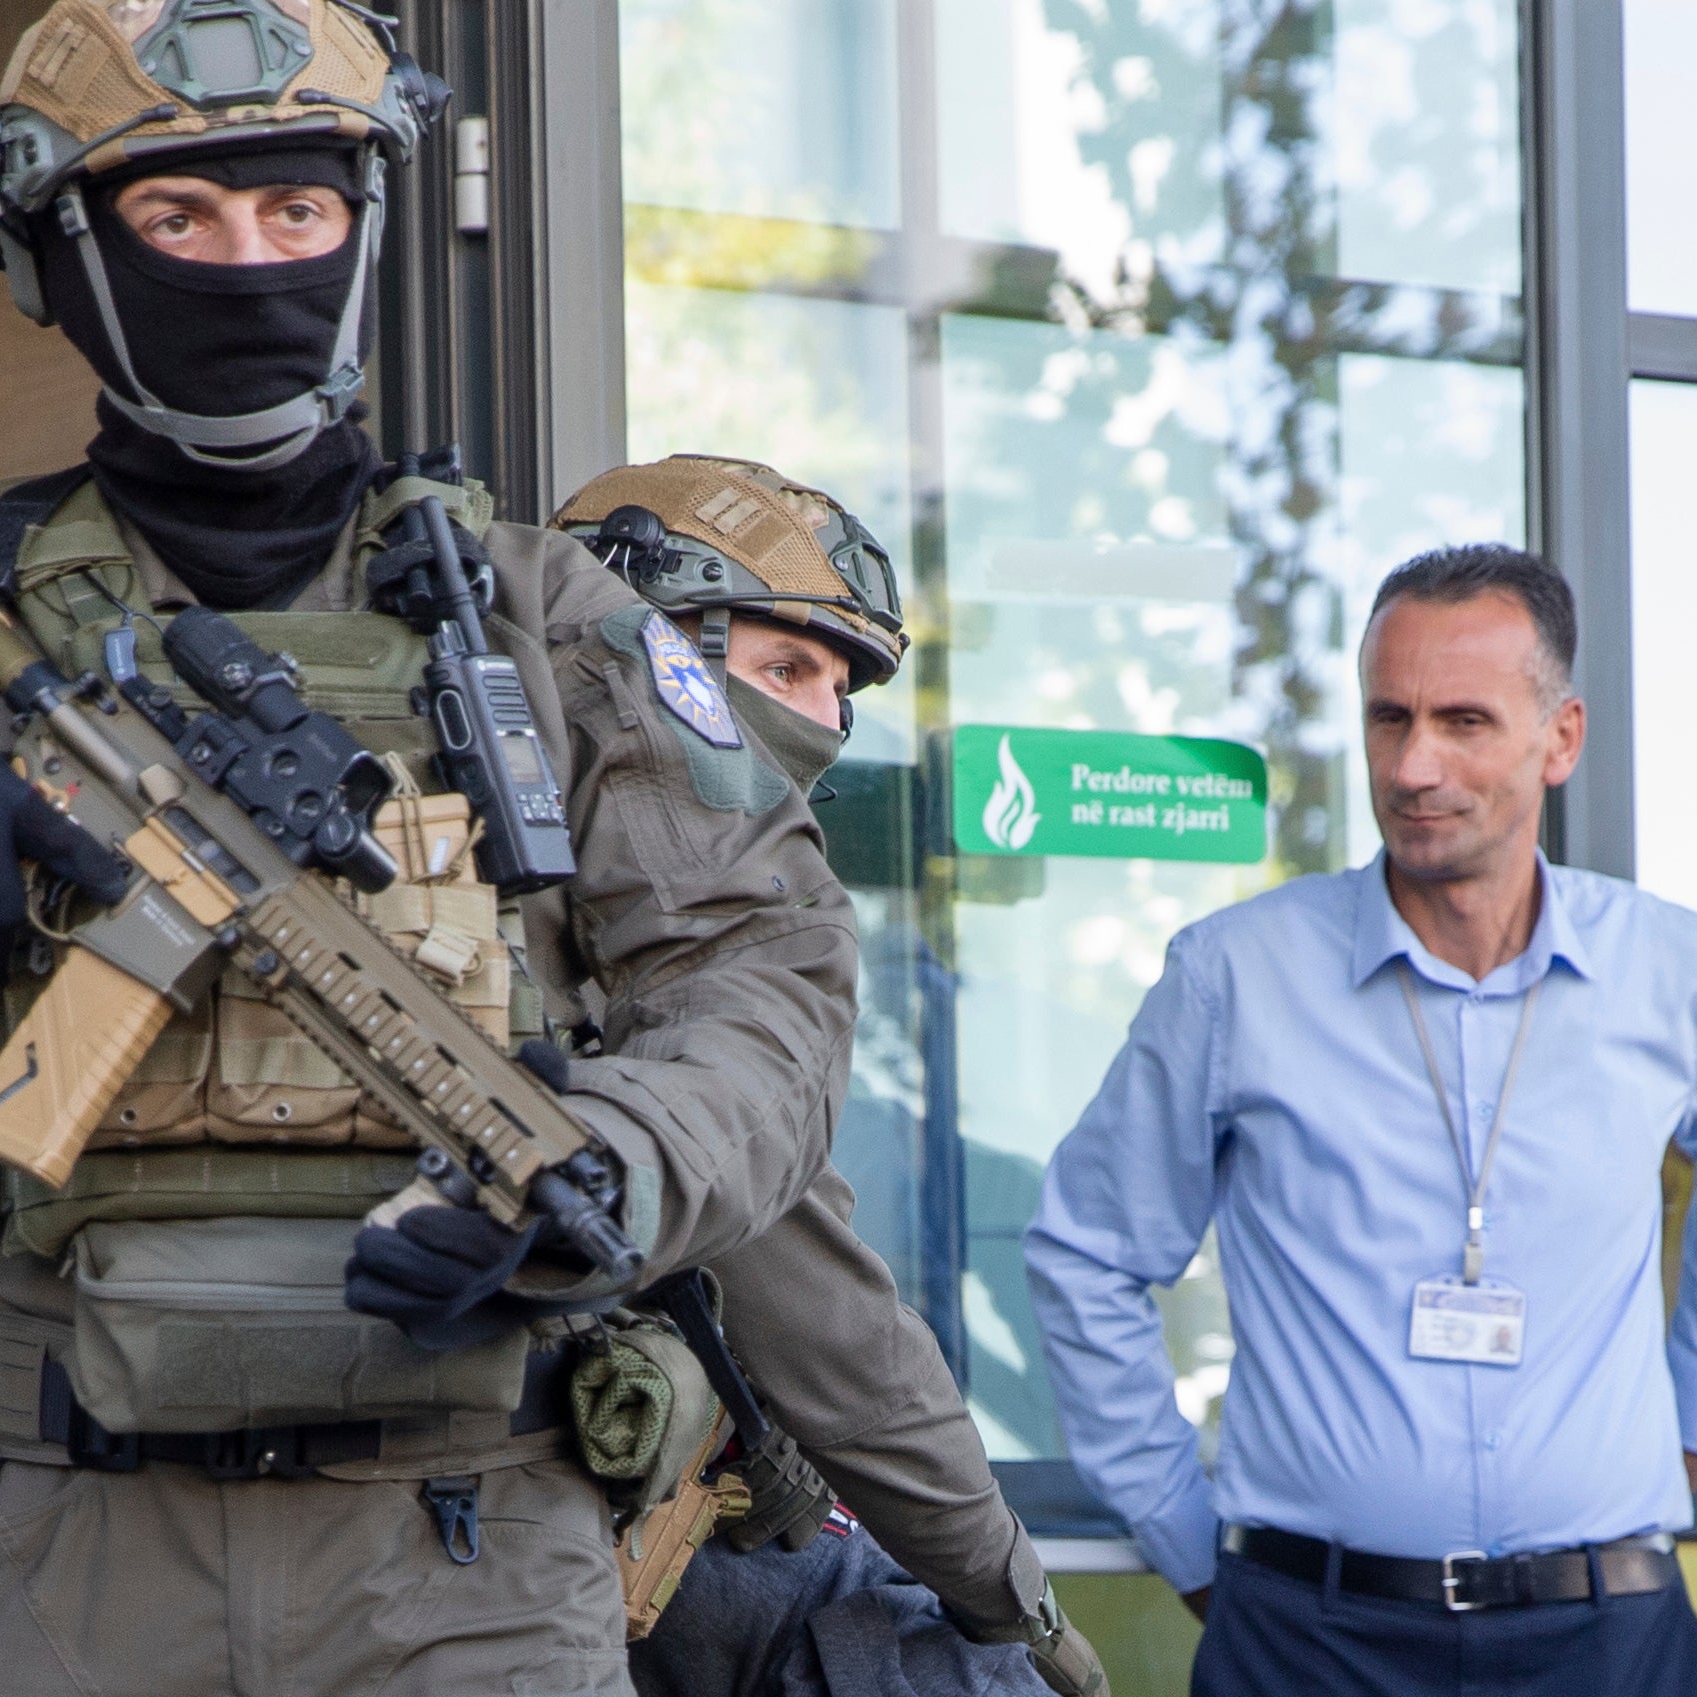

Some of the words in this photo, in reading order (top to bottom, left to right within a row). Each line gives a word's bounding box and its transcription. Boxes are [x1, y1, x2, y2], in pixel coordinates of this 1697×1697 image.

[1071, 801, 1103, 825] në
[1109, 803, 1156, 828] rast
[1161, 802, 1229, 836] zjarri
